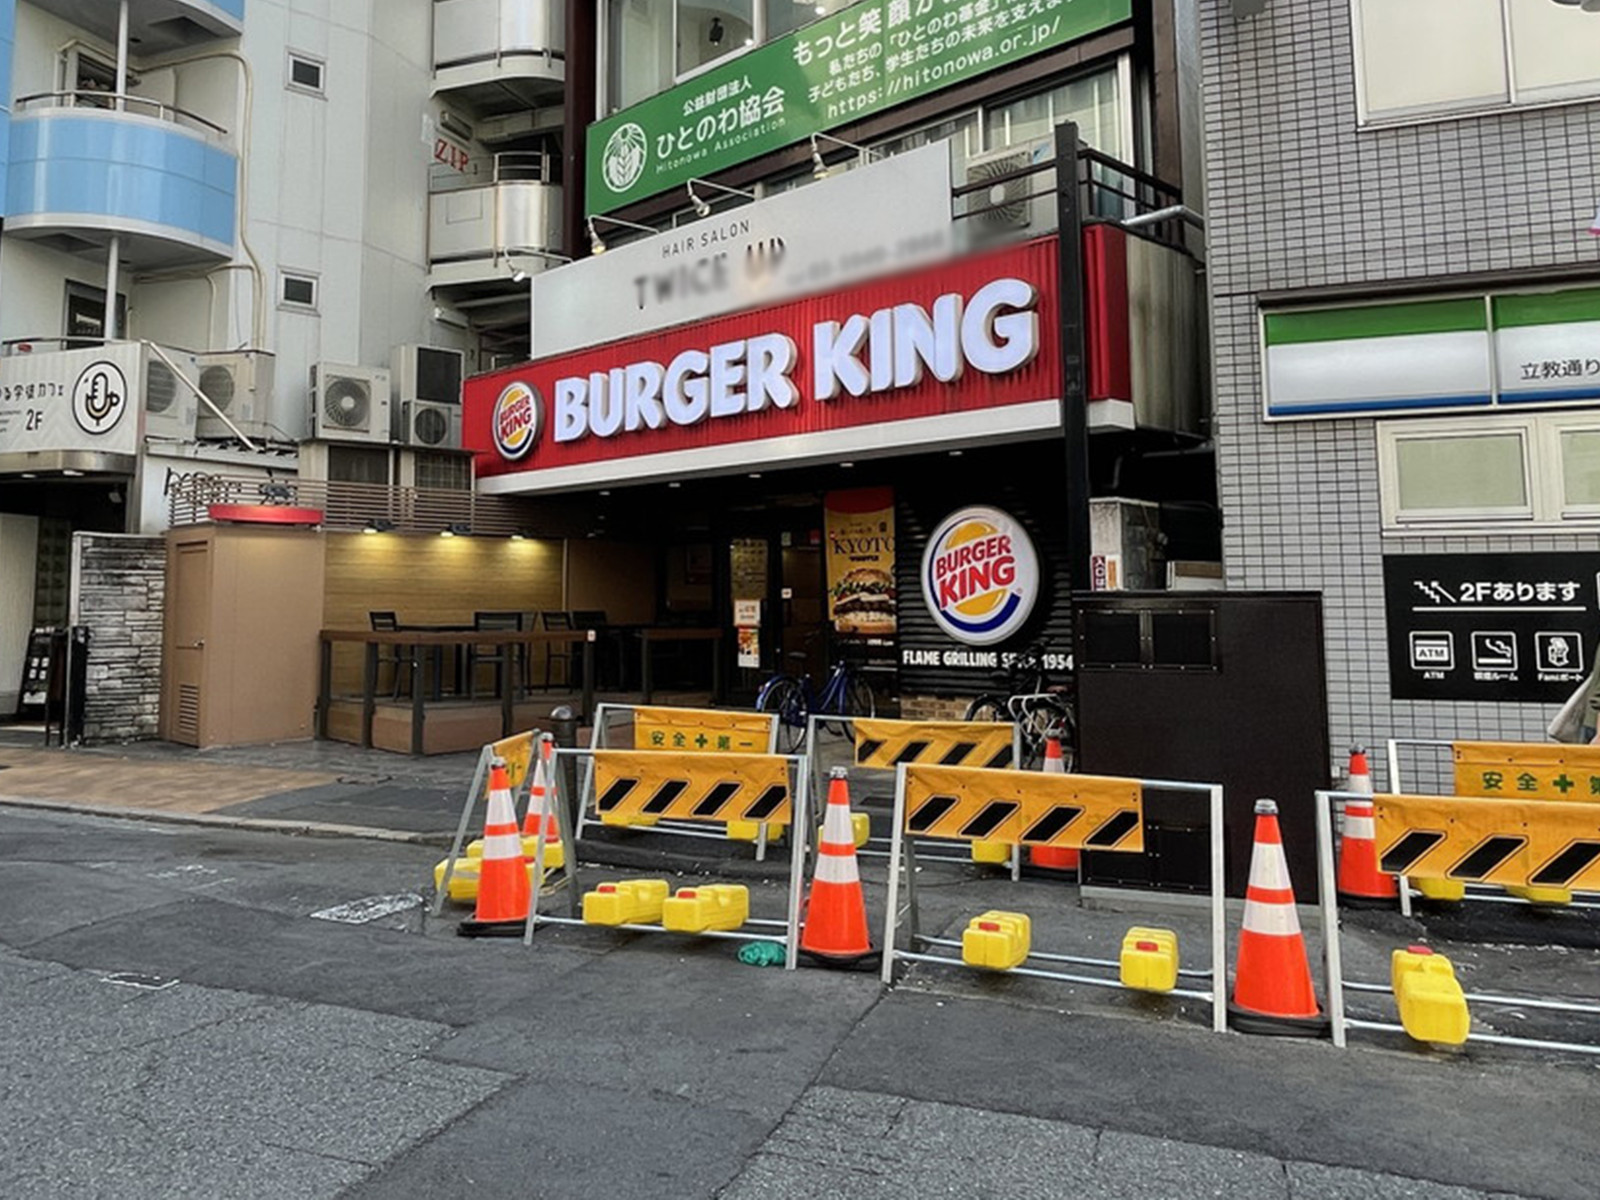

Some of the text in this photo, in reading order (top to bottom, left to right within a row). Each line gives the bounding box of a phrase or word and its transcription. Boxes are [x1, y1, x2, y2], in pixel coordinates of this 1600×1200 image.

[828, 15, 1061, 119] https://hitonowa.or.jp/
[657, 86, 785, 159] ひとのわ協会
[434, 138, 470, 173] ZIP
[656, 118, 786, 174] Hitonowa Association
[662, 220, 750, 259] HAIR SALON
[553, 278, 1039, 443] BURGER KING
[26, 408, 43, 431] 2F
[936, 535, 1012, 579] BURGER
[939, 555, 1015, 608] KING
[1459, 582, 1581, 602] 2Fあります
[903, 650, 941, 666] FLAME
[942, 652, 998, 668] GRILLING
[1041, 654, 1074, 671] 1954
[1419, 648, 1445, 658] ATM
